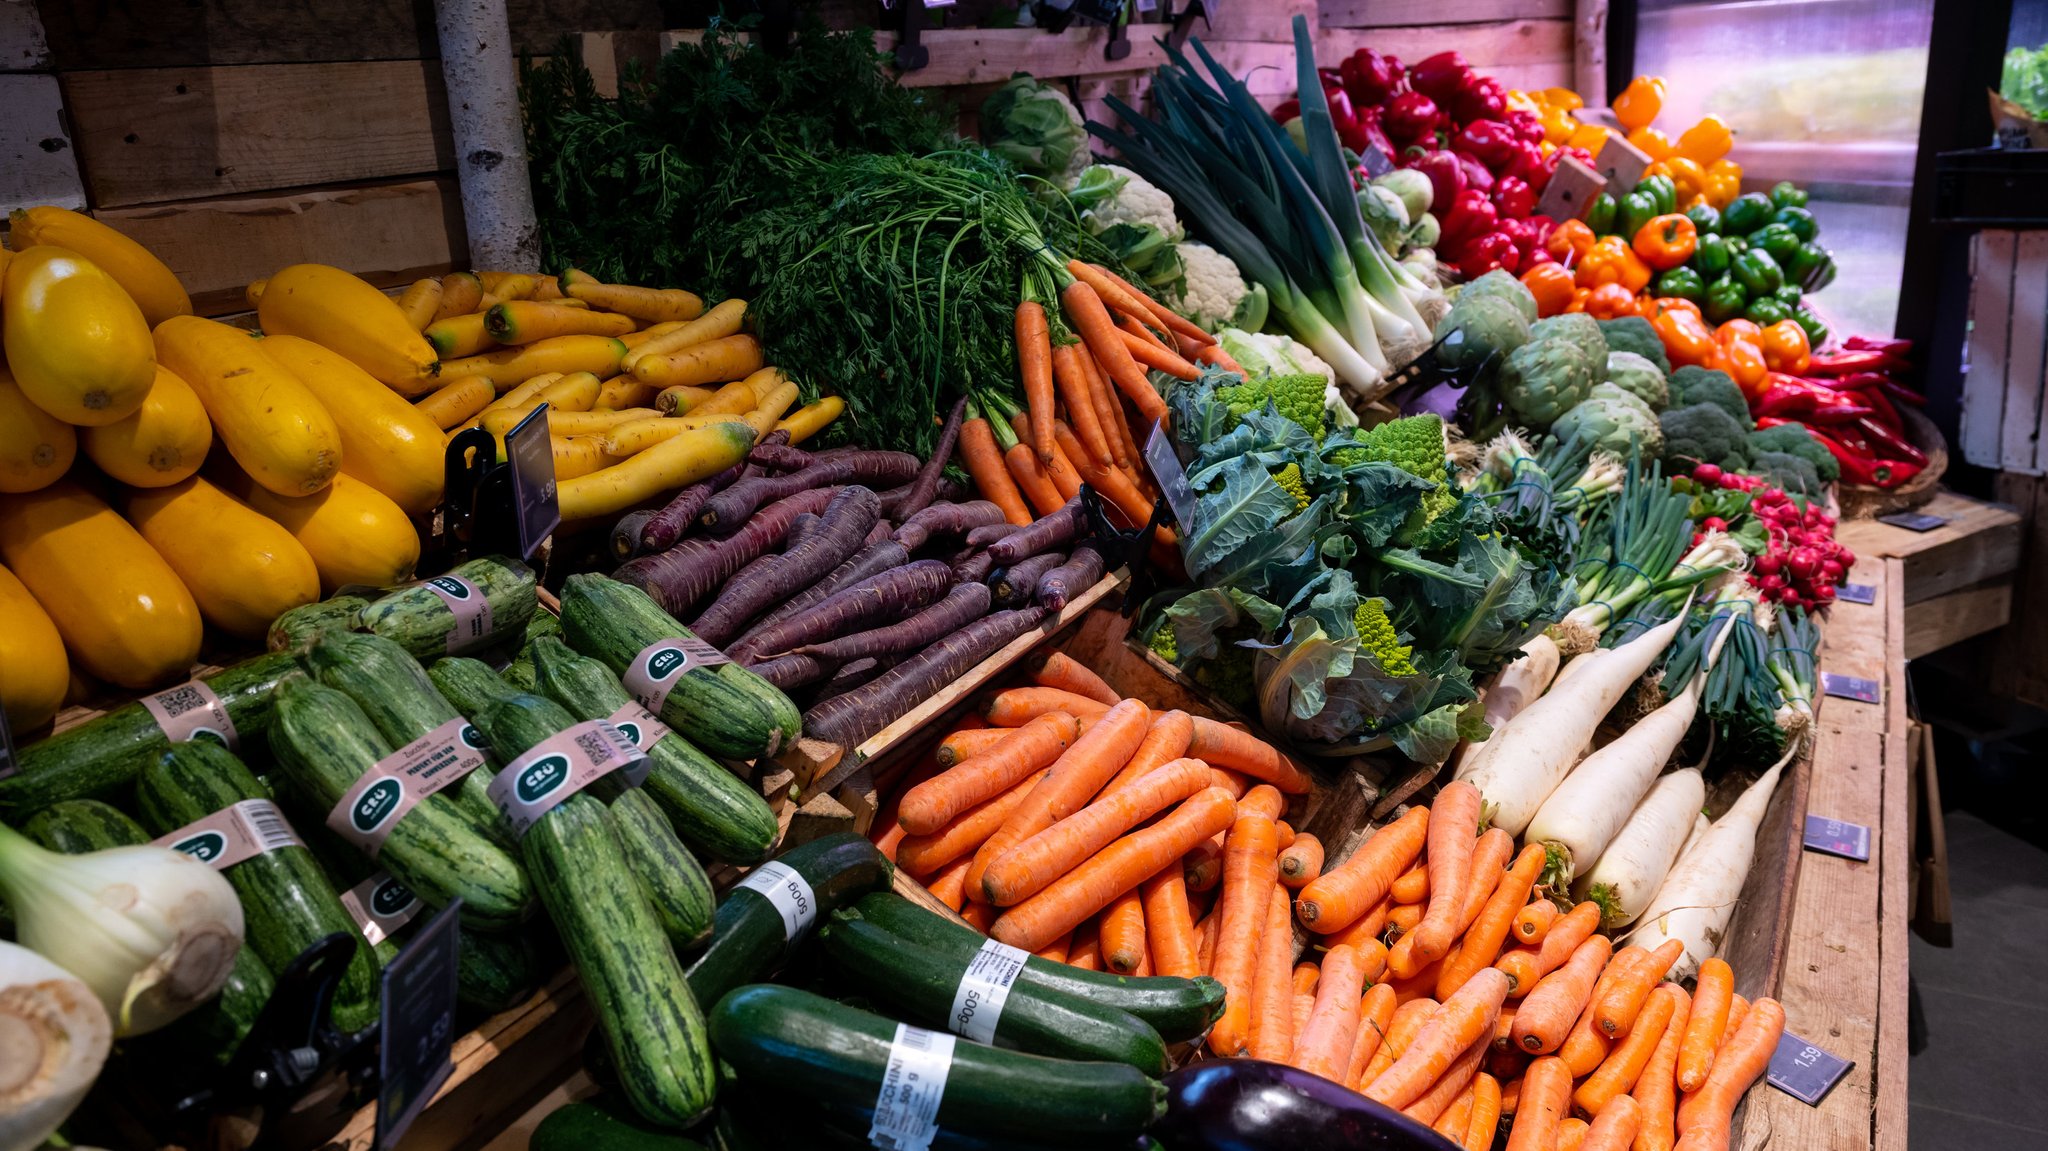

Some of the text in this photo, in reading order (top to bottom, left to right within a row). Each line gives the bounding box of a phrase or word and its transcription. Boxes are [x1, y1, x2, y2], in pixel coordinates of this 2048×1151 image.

[654, 652, 675, 668] CRÜ
[525, 762, 555, 787] CRÜ
[361, 788, 387, 816] CRÜ
[382, 885, 404, 901] CR
[787, 881, 808, 915] 500g
[957, 989, 981, 1024] 500g
[1793, 1046, 1823, 1068] 1.59
[899, 1072, 919, 1105] 500 g
